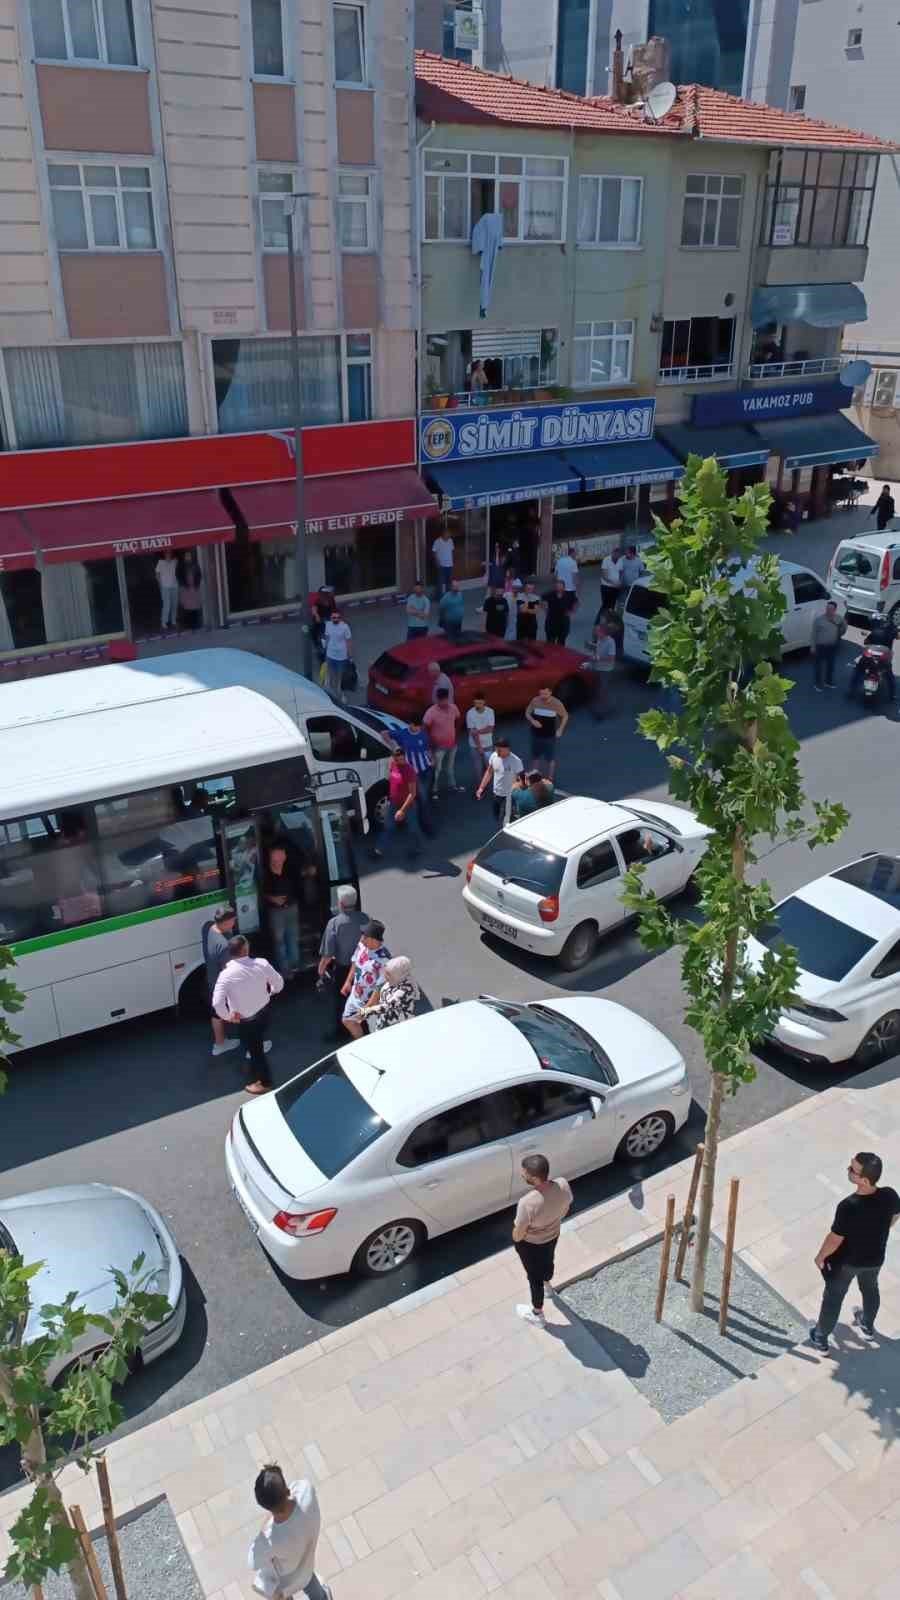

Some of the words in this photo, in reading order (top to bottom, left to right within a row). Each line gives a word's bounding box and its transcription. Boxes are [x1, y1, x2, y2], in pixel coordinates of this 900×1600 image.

[743, 394, 791, 411] YAKAMOZ
[792, 391, 814, 406] PUB
[459, 412, 538, 456] SİMİT
[541, 407, 652, 446] DÜNYASI
[361, 510, 405, 526] PERDE
